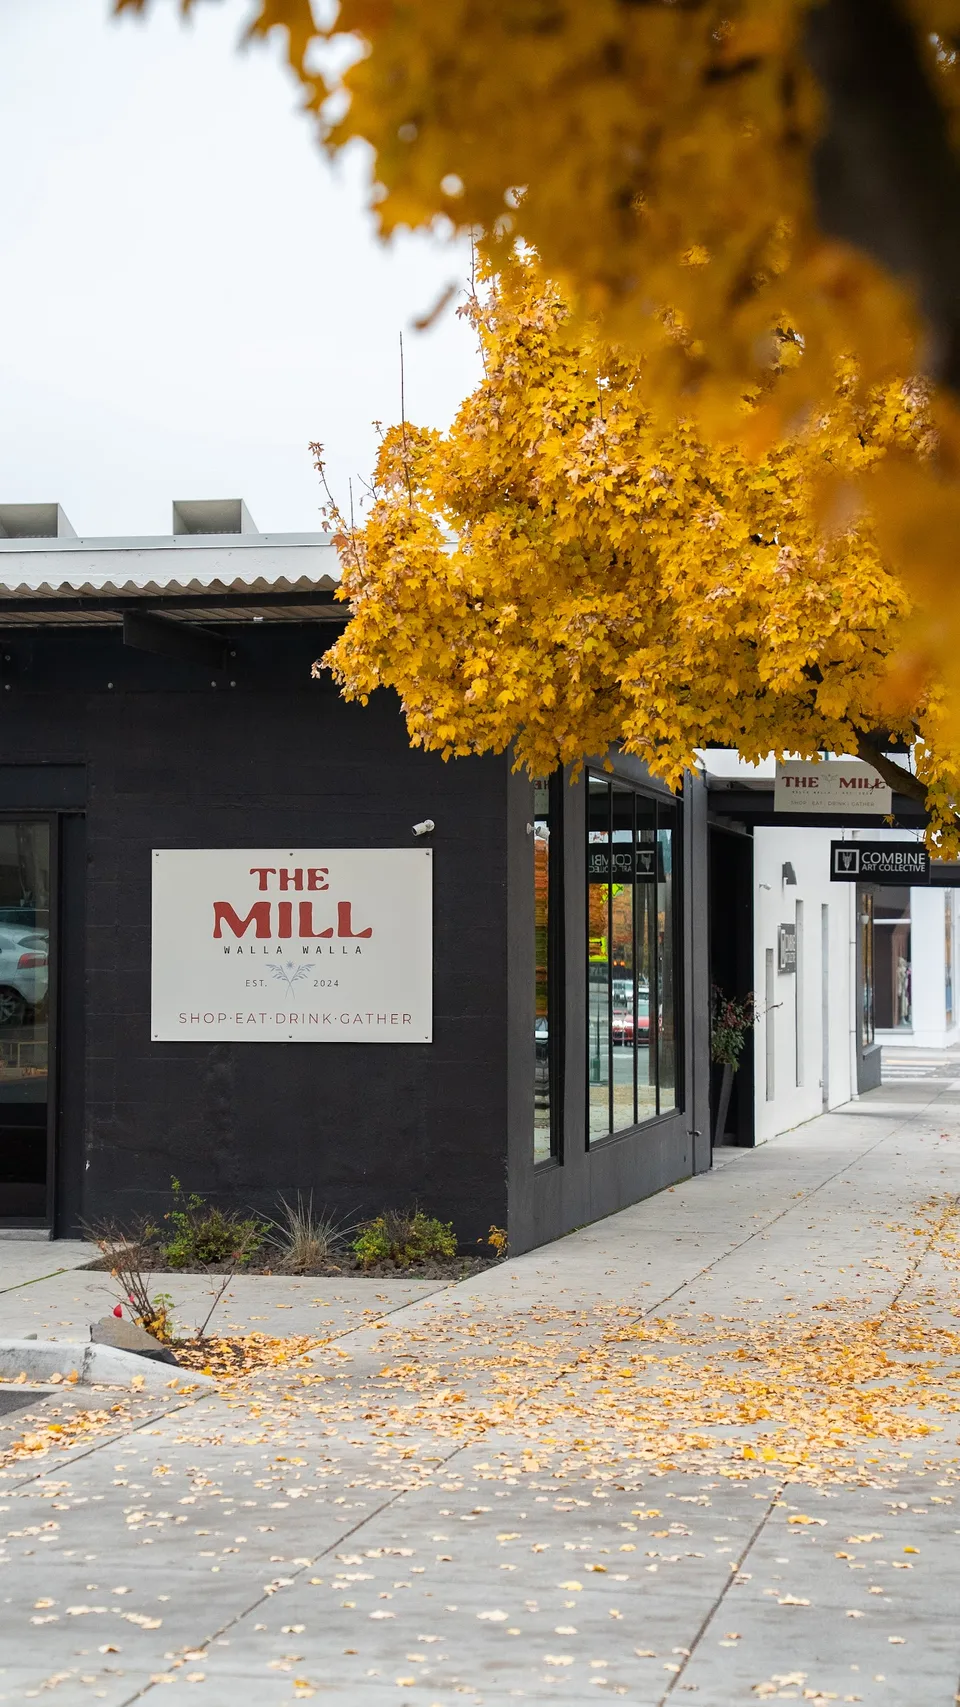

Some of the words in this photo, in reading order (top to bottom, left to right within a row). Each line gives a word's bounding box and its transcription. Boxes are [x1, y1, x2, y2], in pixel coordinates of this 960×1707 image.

[781, 776, 819, 788] THE
[839, 777, 885, 789] MILL
[861, 852, 926, 865] COMBINE
[878, 864, 926, 872] COLLECTIVE
[249, 868, 330, 891] THE
[212, 901, 373, 939] MILL
[223, 945, 283, 955] WALLA
[302, 945, 363, 955] WALLA
[245, 979, 268, 988] EST.
[313, 979, 340, 988] 2024
